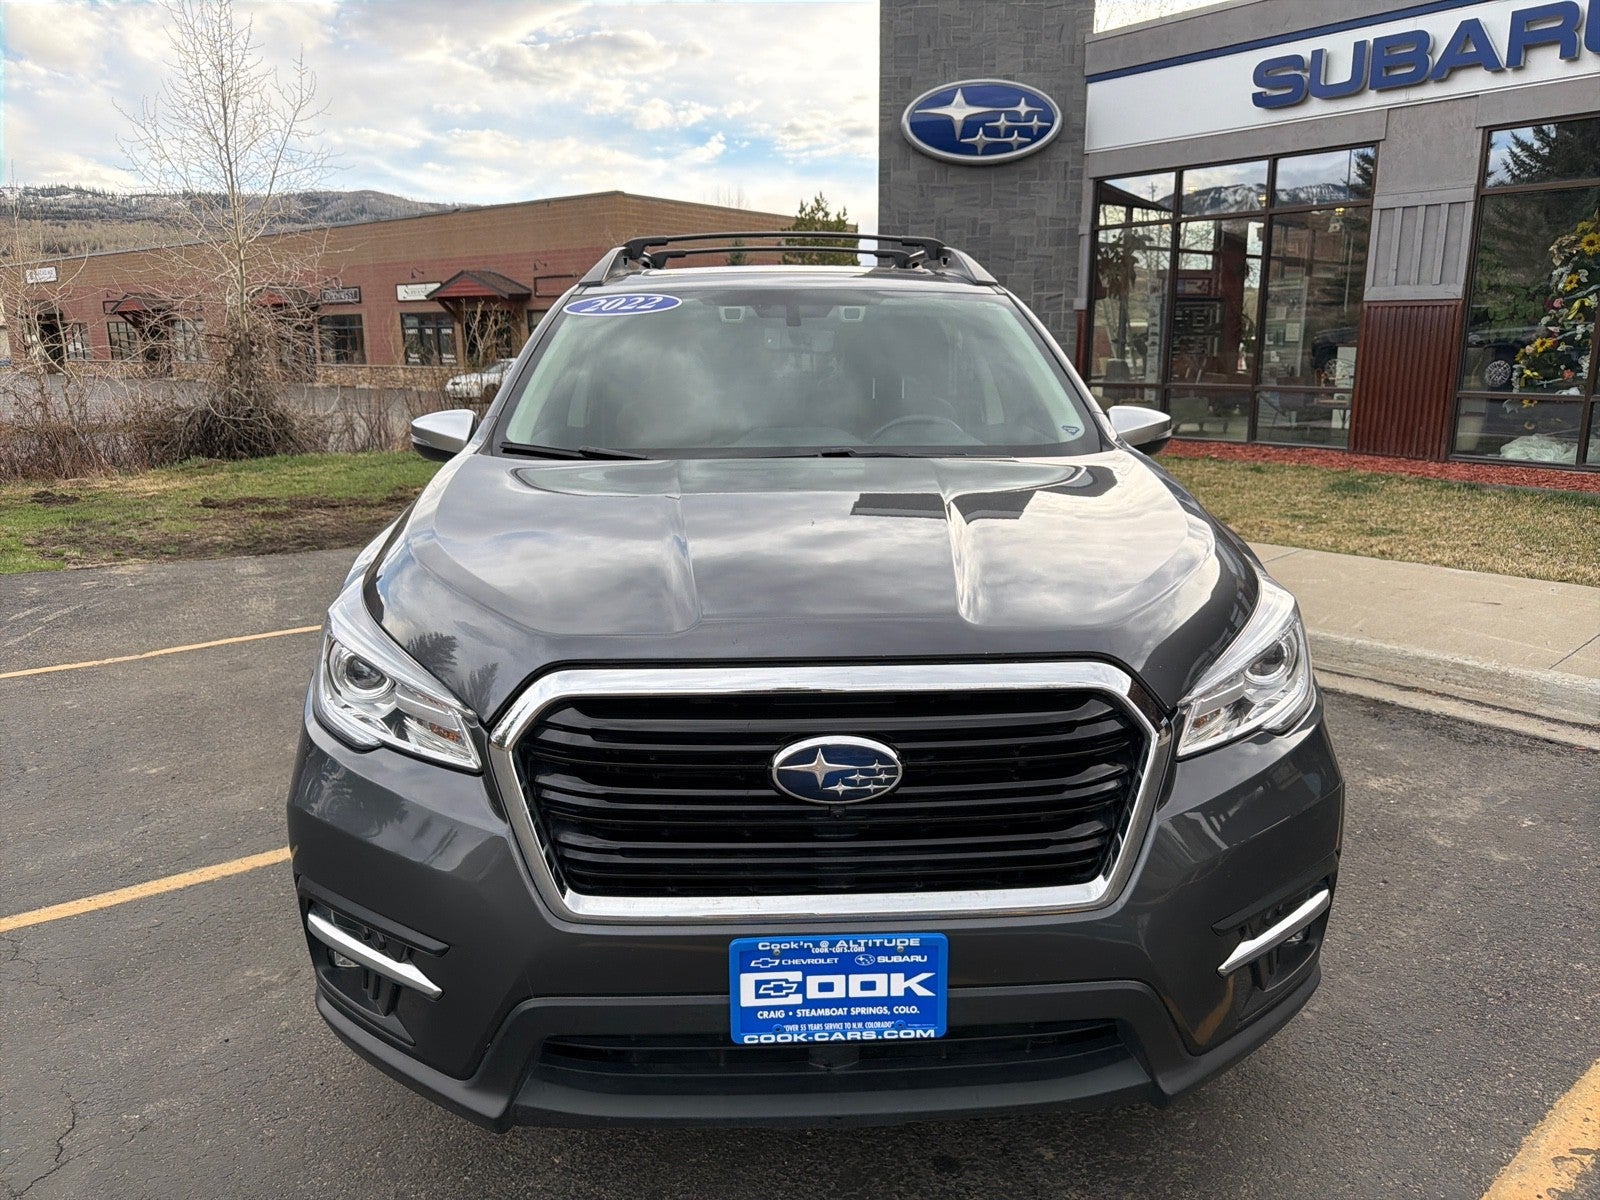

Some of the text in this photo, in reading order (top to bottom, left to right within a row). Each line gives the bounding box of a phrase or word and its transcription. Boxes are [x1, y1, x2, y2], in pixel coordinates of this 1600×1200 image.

[1252, 0, 1600, 109] SUBAR
[580, 297, 664, 312] 2022
[758, 937, 921, 951] Cook'n @ ALTITUDE
[812, 945, 865, 954] cook-cars.com
[782, 957, 839, 966] CHEVROLET
[877, 955, 927, 963] SUBARU
[740, 971, 936, 1007] COOK
[757, 1005, 920, 1019] CRAIG STEAMBOAT SPRINGS, COLO.
[808, 1023, 824, 1031] YEARS
[825, 1022, 843, 1031] SERVICE
[743, 1030, 935, 1044] COOK-CARS.COM
